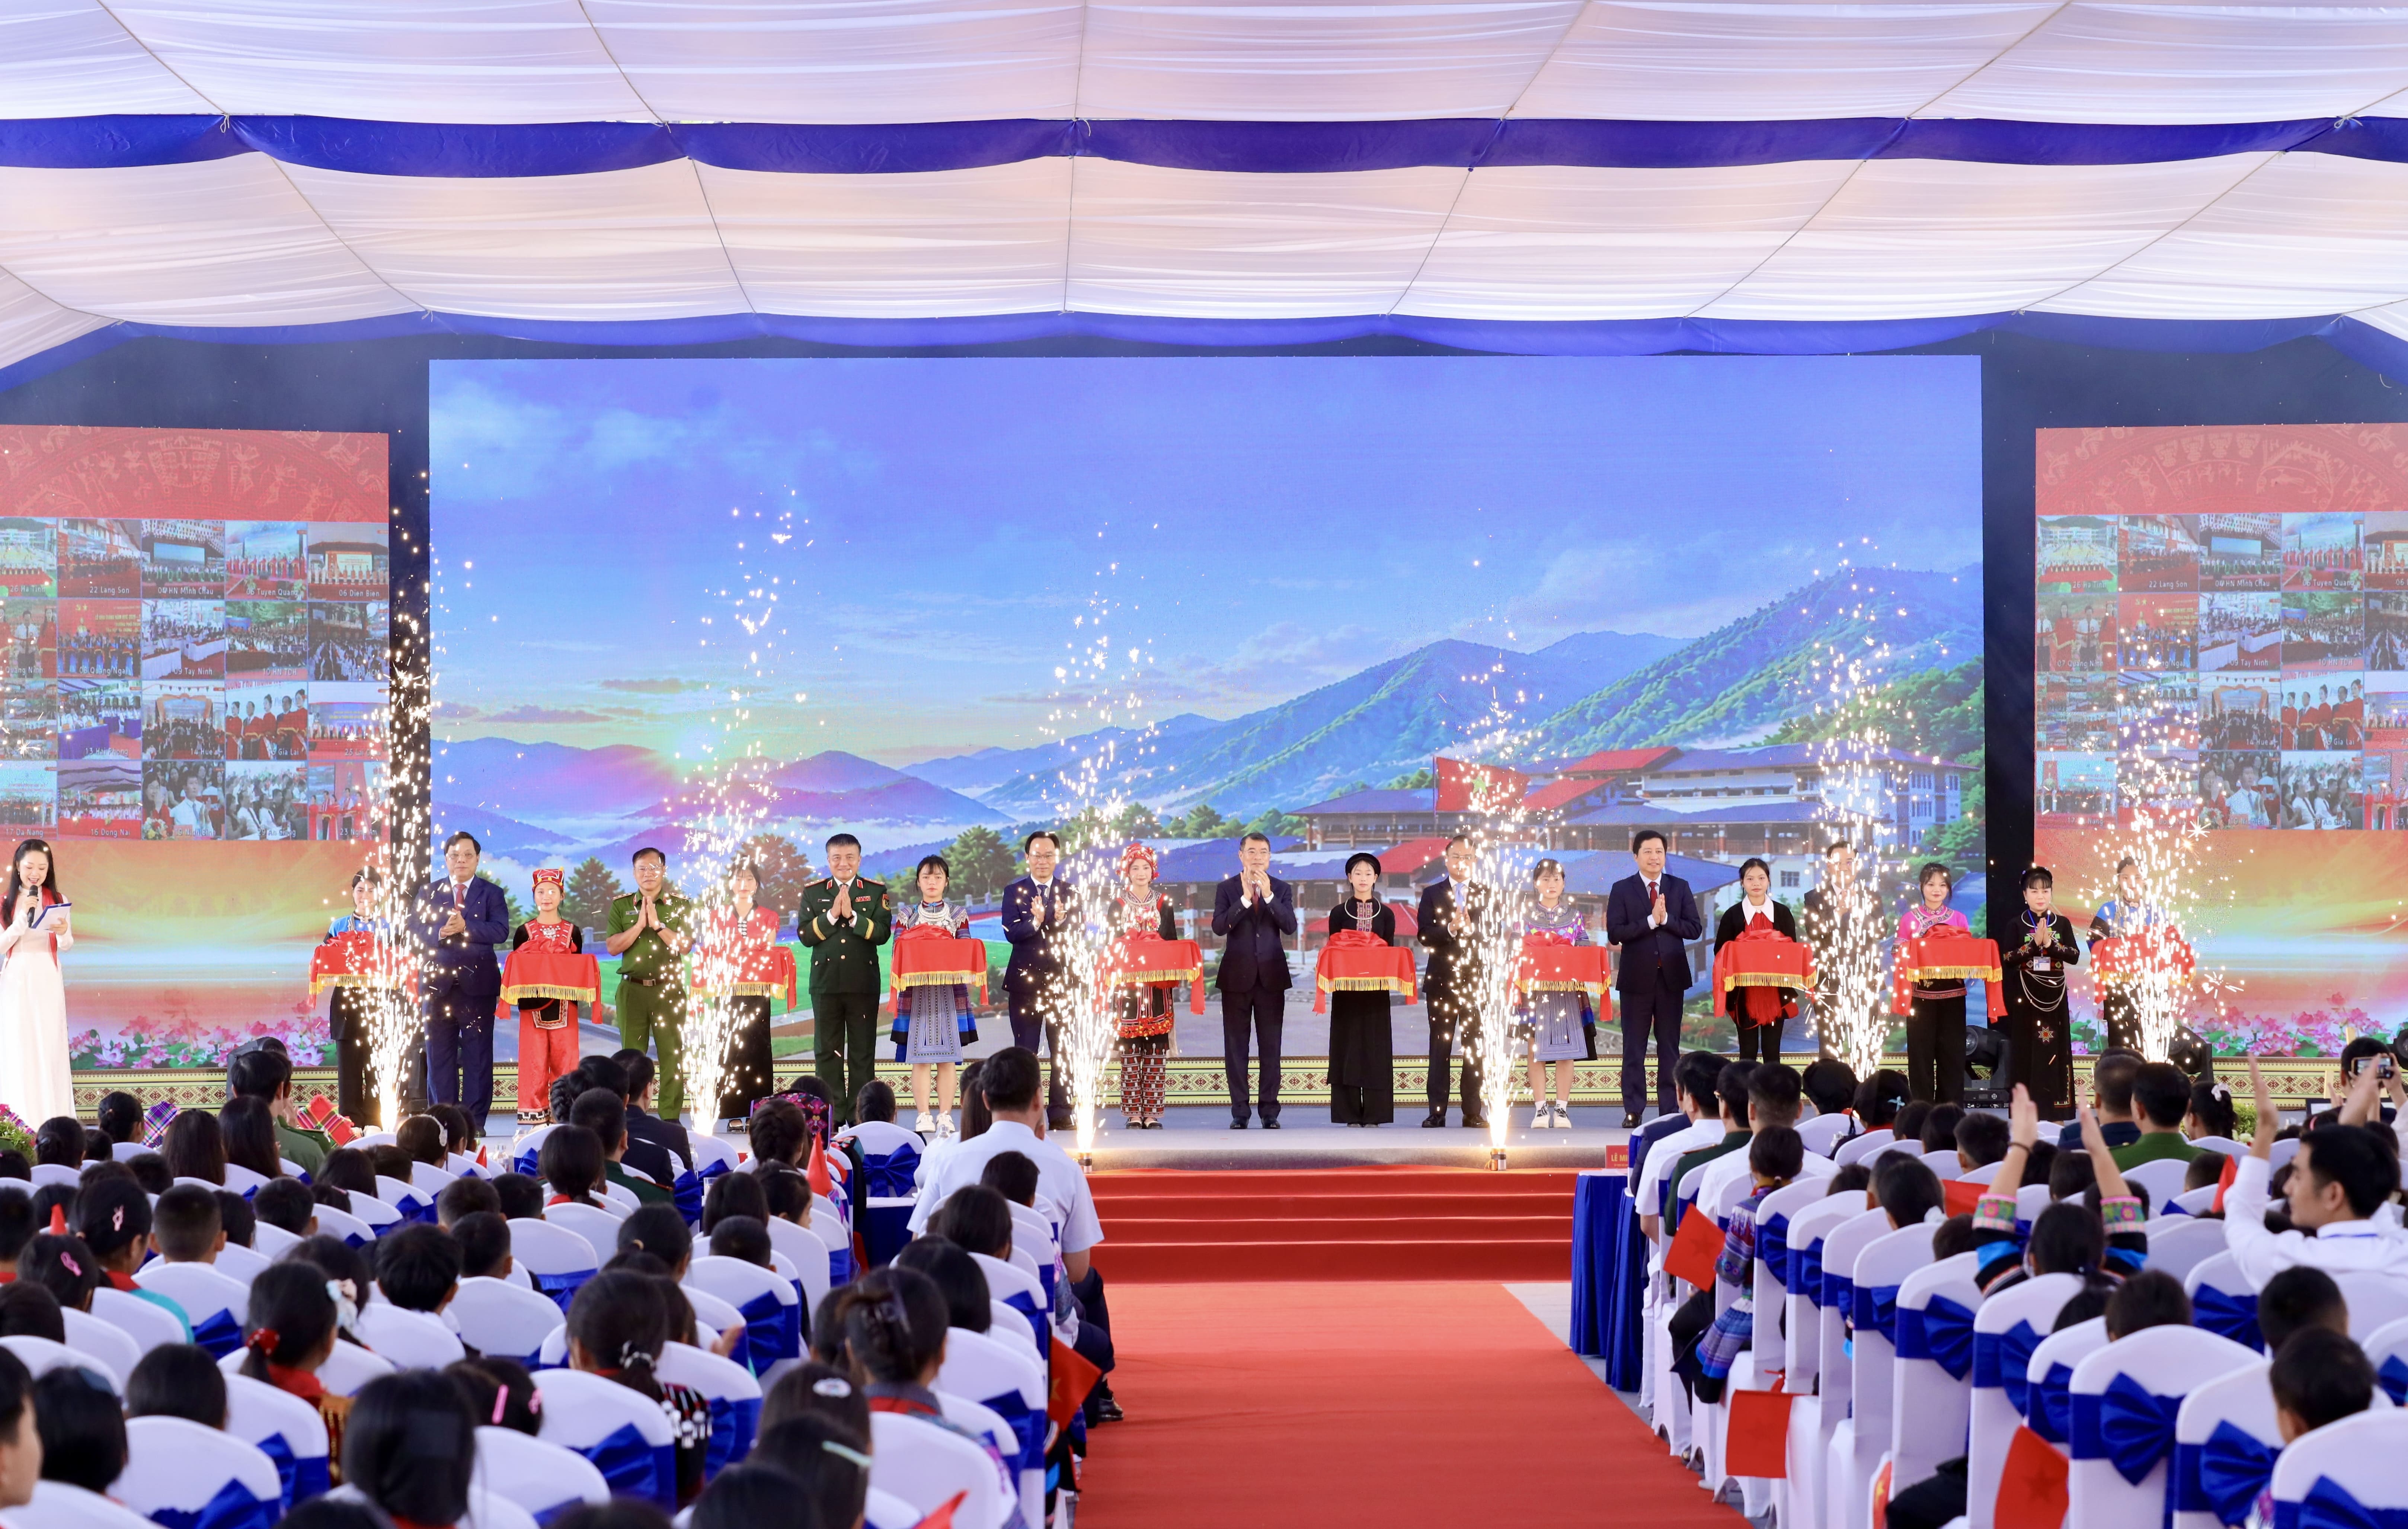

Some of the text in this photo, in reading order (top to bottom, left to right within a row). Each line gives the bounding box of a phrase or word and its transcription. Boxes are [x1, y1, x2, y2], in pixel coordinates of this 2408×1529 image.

[2159, 580, 2174, 590] Lang
[2313, 579, 2332, 588] Tuyen
[100, 586, 115, 596] Lang
[198, 586, 213, 594] Chau
[257, 588, 276, 597] Tuyen
[278, 589, 298, 598] Quang
[2241, 658, 2251, 667] Tay
[185, 667, 195, 676] Tay
[101, 828, 117, 838] Dong
[1611, 1152, 1618, 1162] LÊ
